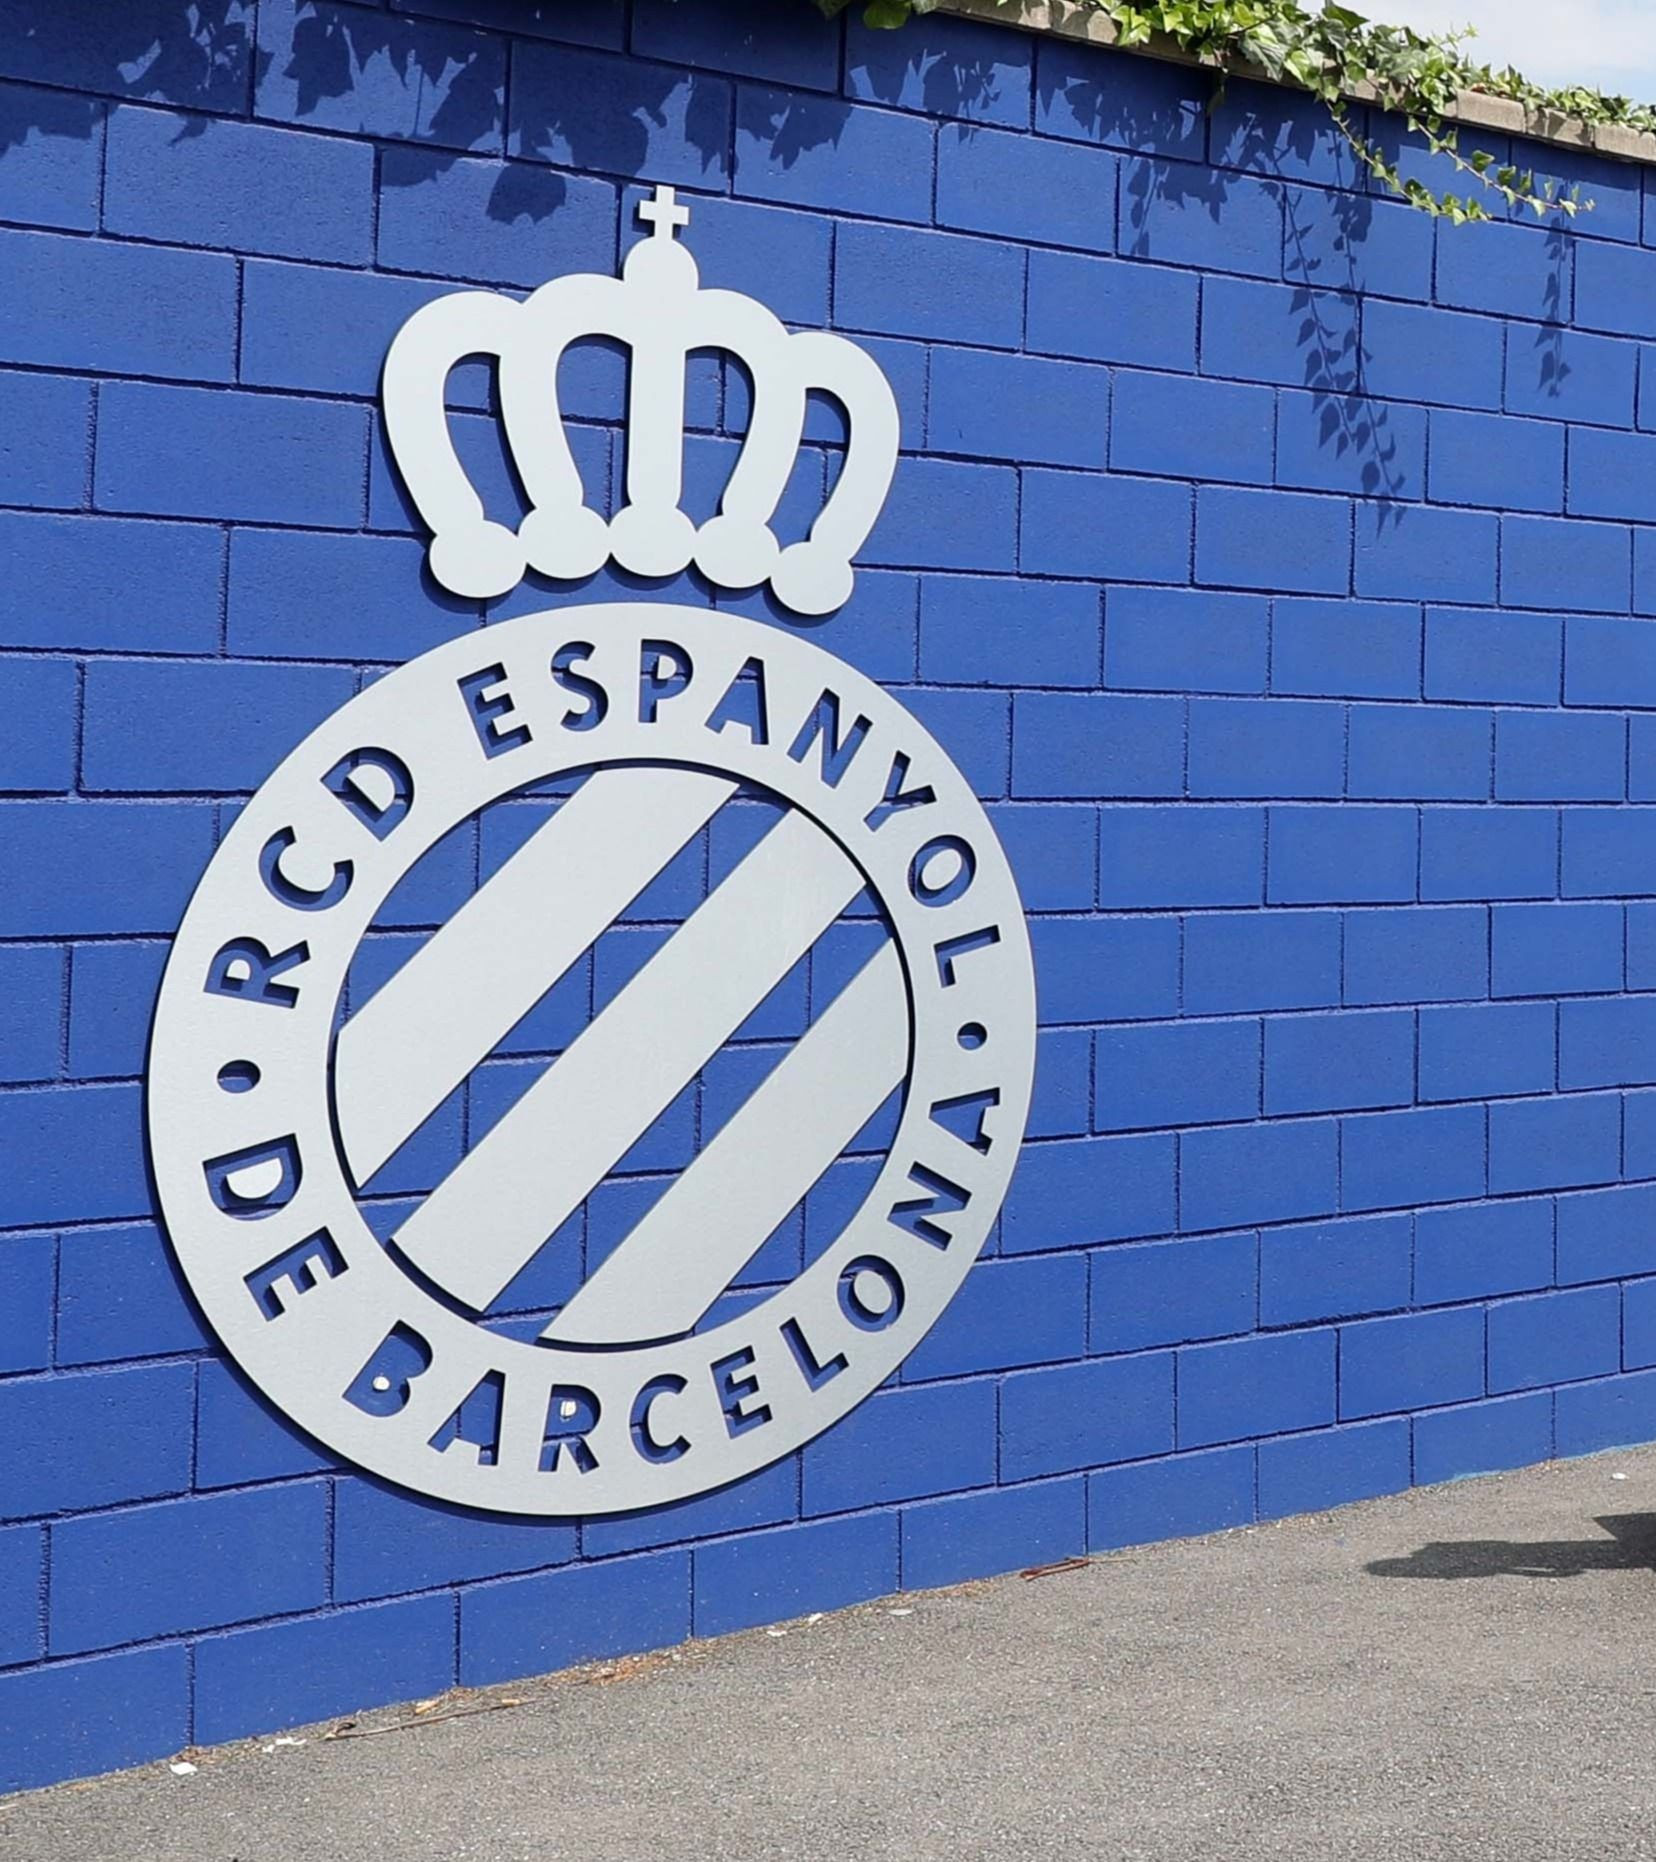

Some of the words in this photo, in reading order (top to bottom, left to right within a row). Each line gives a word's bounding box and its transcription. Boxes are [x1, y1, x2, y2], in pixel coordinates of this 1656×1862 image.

[202, 745, 416, 1010] RCD
[456, 637, 1001, 990] ESPANYOL
[202, 1132, 350, 1322] DE
[341, 1086, 1001, 1475] BARCELONA
